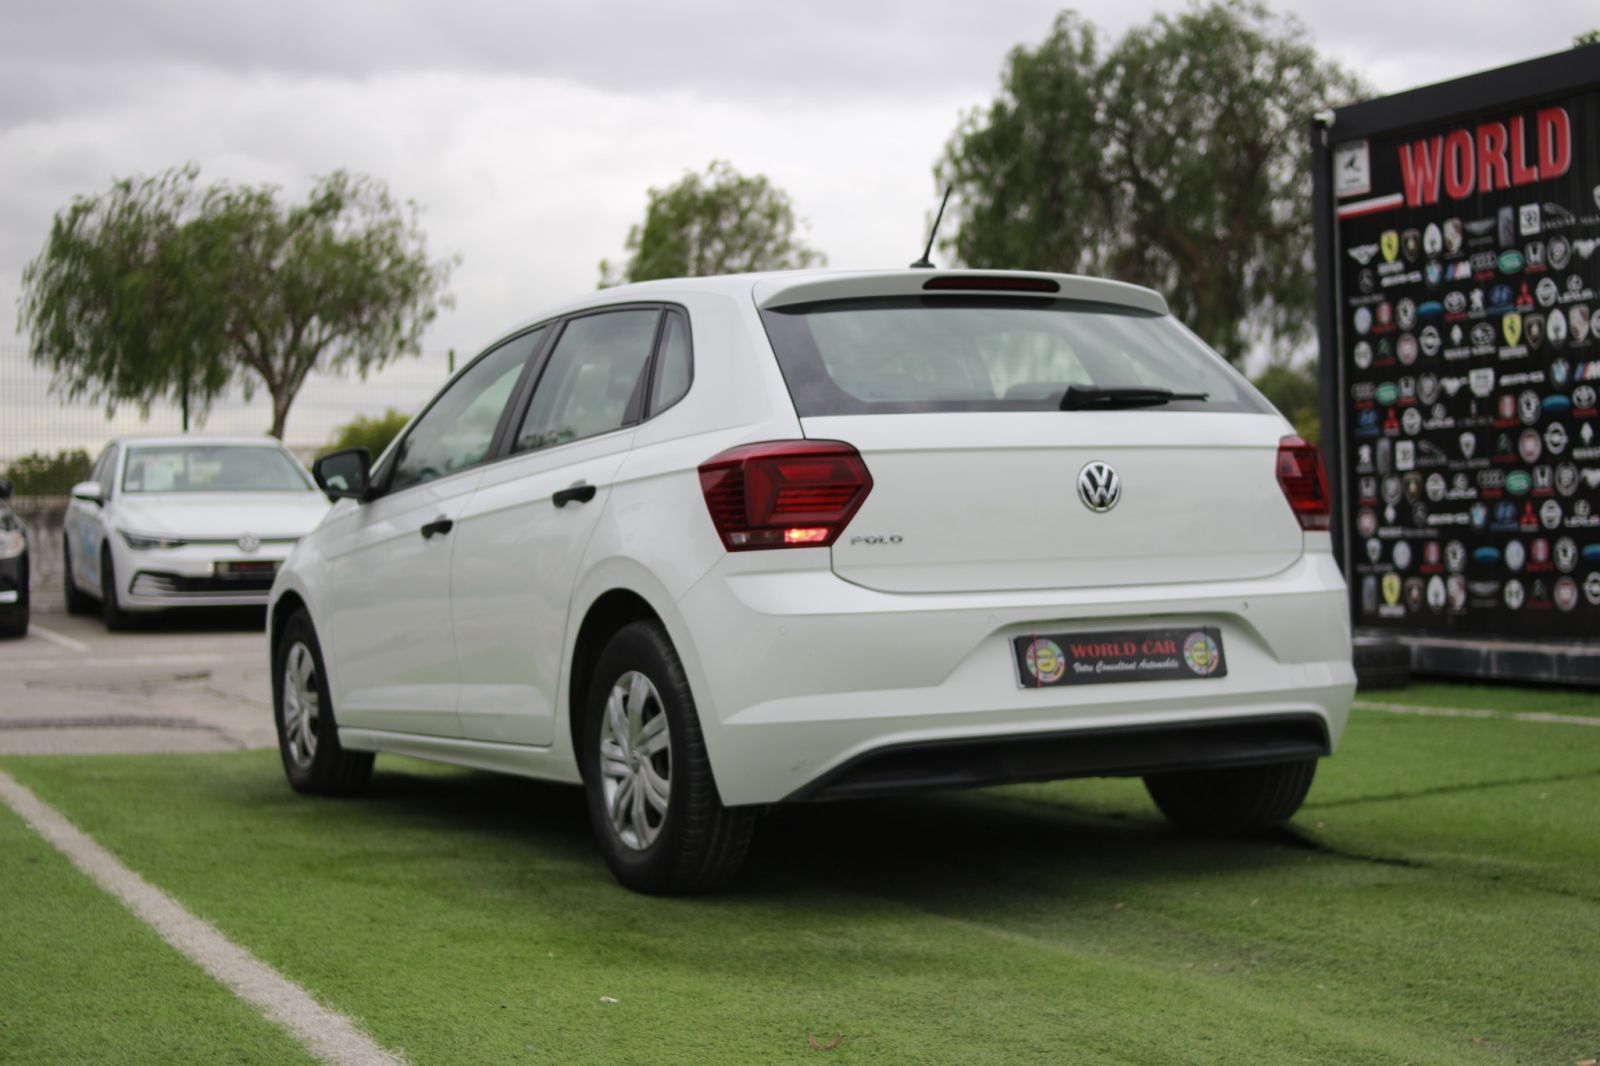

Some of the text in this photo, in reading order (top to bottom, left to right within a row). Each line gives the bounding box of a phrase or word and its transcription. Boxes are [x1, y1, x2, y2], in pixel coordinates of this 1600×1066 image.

[1397, 106, 1572, 208] WORLD
[1077, 460, 1120, 512] VW
[850, 534, 903, 546] POLO
[1071, 639, 1177, 658] WORLD CAR
